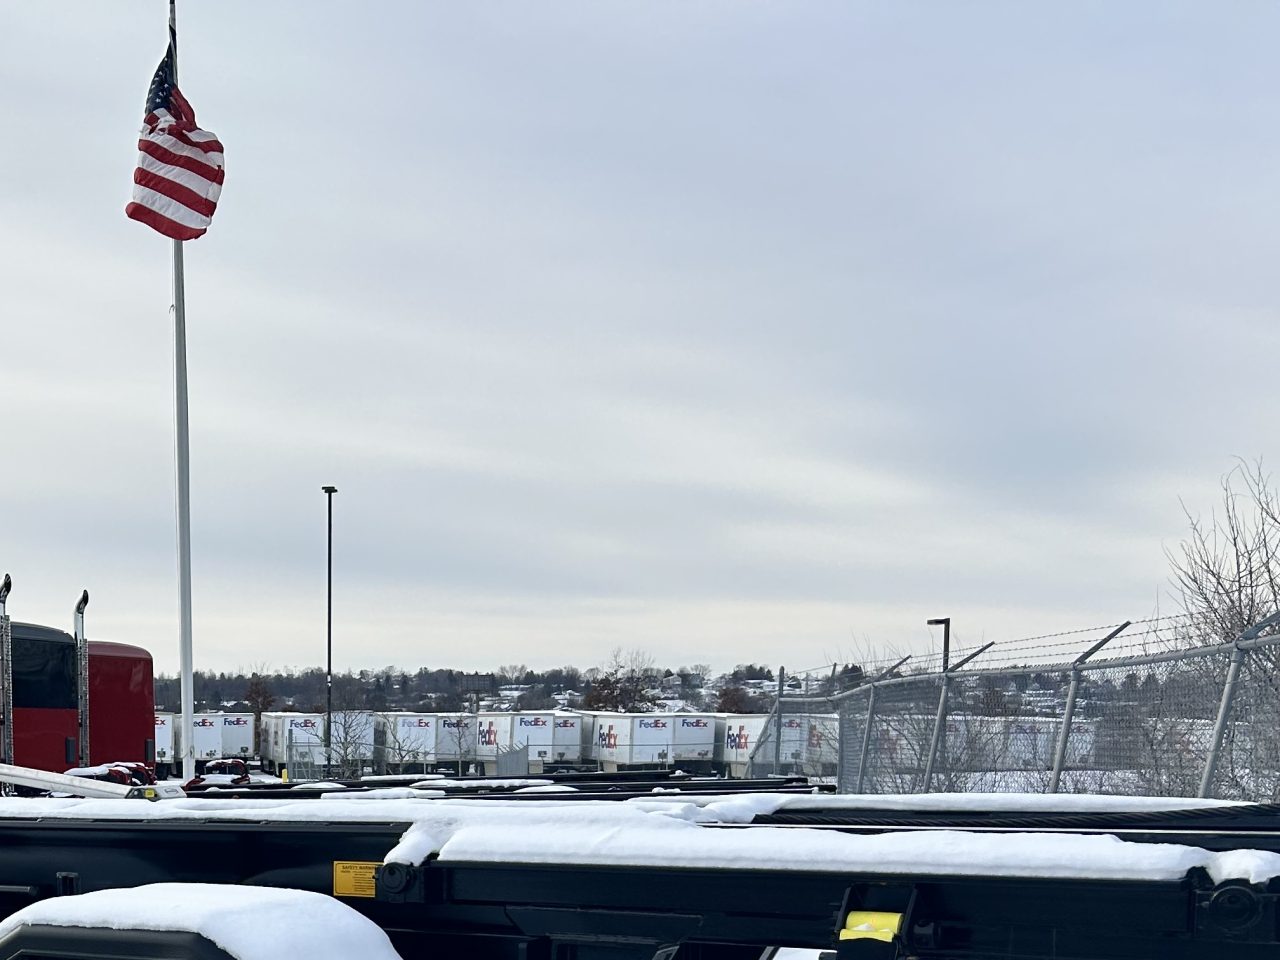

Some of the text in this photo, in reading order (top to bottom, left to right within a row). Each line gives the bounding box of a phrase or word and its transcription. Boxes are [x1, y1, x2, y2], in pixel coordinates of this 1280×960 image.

[193, 718, 214, 727] edEx
[223, 717, 248, 726] FedEx
[289, 719, 316, 728] FedEx
[401, 719, 430, 728] FedEx
[442, 719, 469, 728] FedEx
[519, 717, 547, 727] FedEx
[554, 719, 575, 728] edEx
[639, 719, 668, 729] FedEx
[681, 719, 708, 728] FedEx
[477, 721, 497, 746] FedEx
[599, 724, 618, 749] FedEx
[726, 725, 749, 750] FedEx
